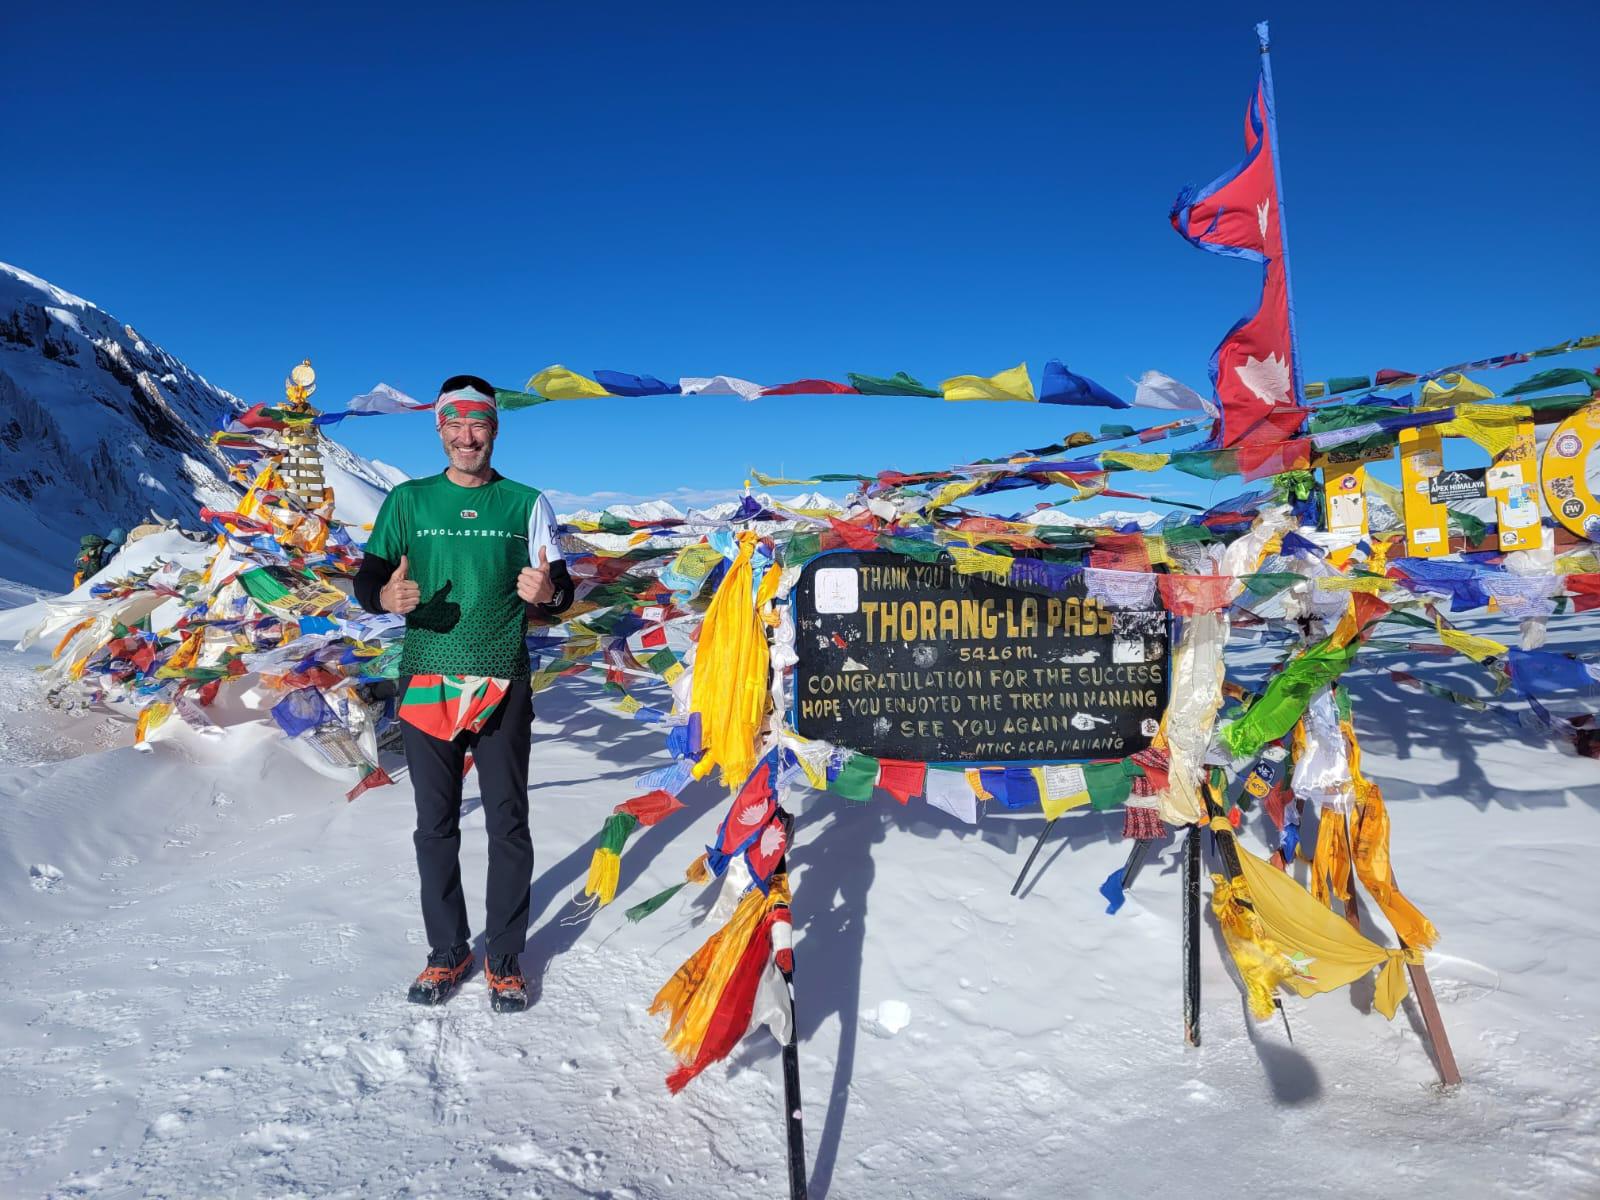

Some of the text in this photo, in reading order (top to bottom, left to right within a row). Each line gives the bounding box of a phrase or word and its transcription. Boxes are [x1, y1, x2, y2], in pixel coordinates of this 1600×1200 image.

[1431, 481, 1485, 493] APEX HIMALAYA
[859, 566, 911, 591] THANK
[914, 565, 944, 589] YOU
[861, 597, 1113, 642] THORANG-LA PASS
[808, 664, 1162, 695] CONGRATULATION FOR THE SUCCESS
[801, 690, 1158, 719] HOPE YOU ENJOYED THE TREK IN MANANG
[900, 715, 1068, 738] SEE YOU AGAIN
